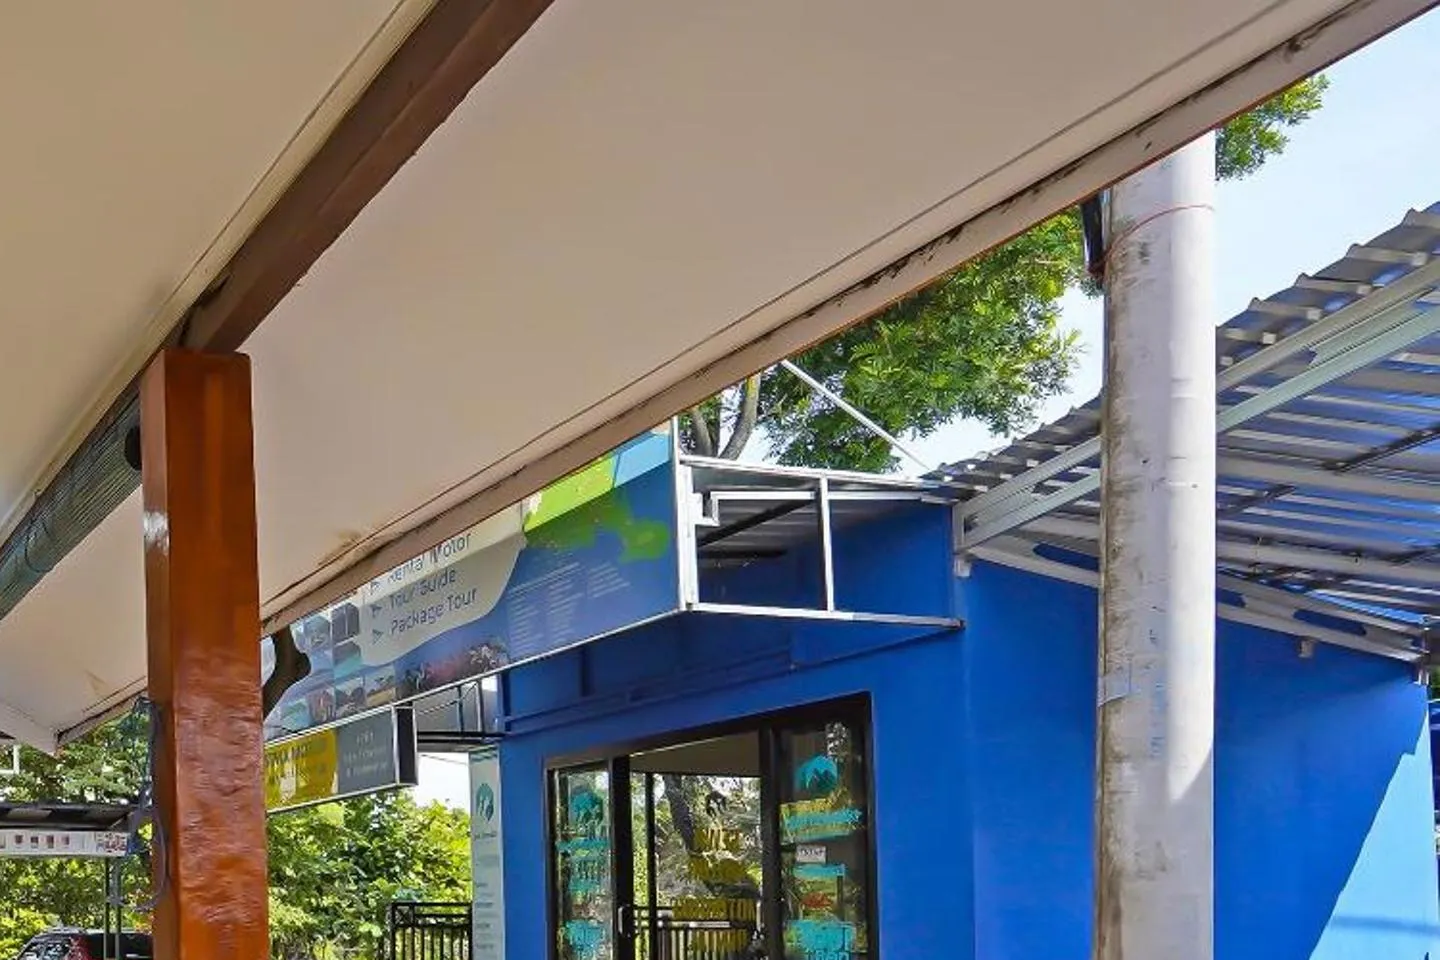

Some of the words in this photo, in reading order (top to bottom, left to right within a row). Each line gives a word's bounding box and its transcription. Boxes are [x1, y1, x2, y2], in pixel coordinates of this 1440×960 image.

[418, 568, 457, 596] Guide
[391, 604, 444, 635] Package
[447, 587, 478, 612] Tour
